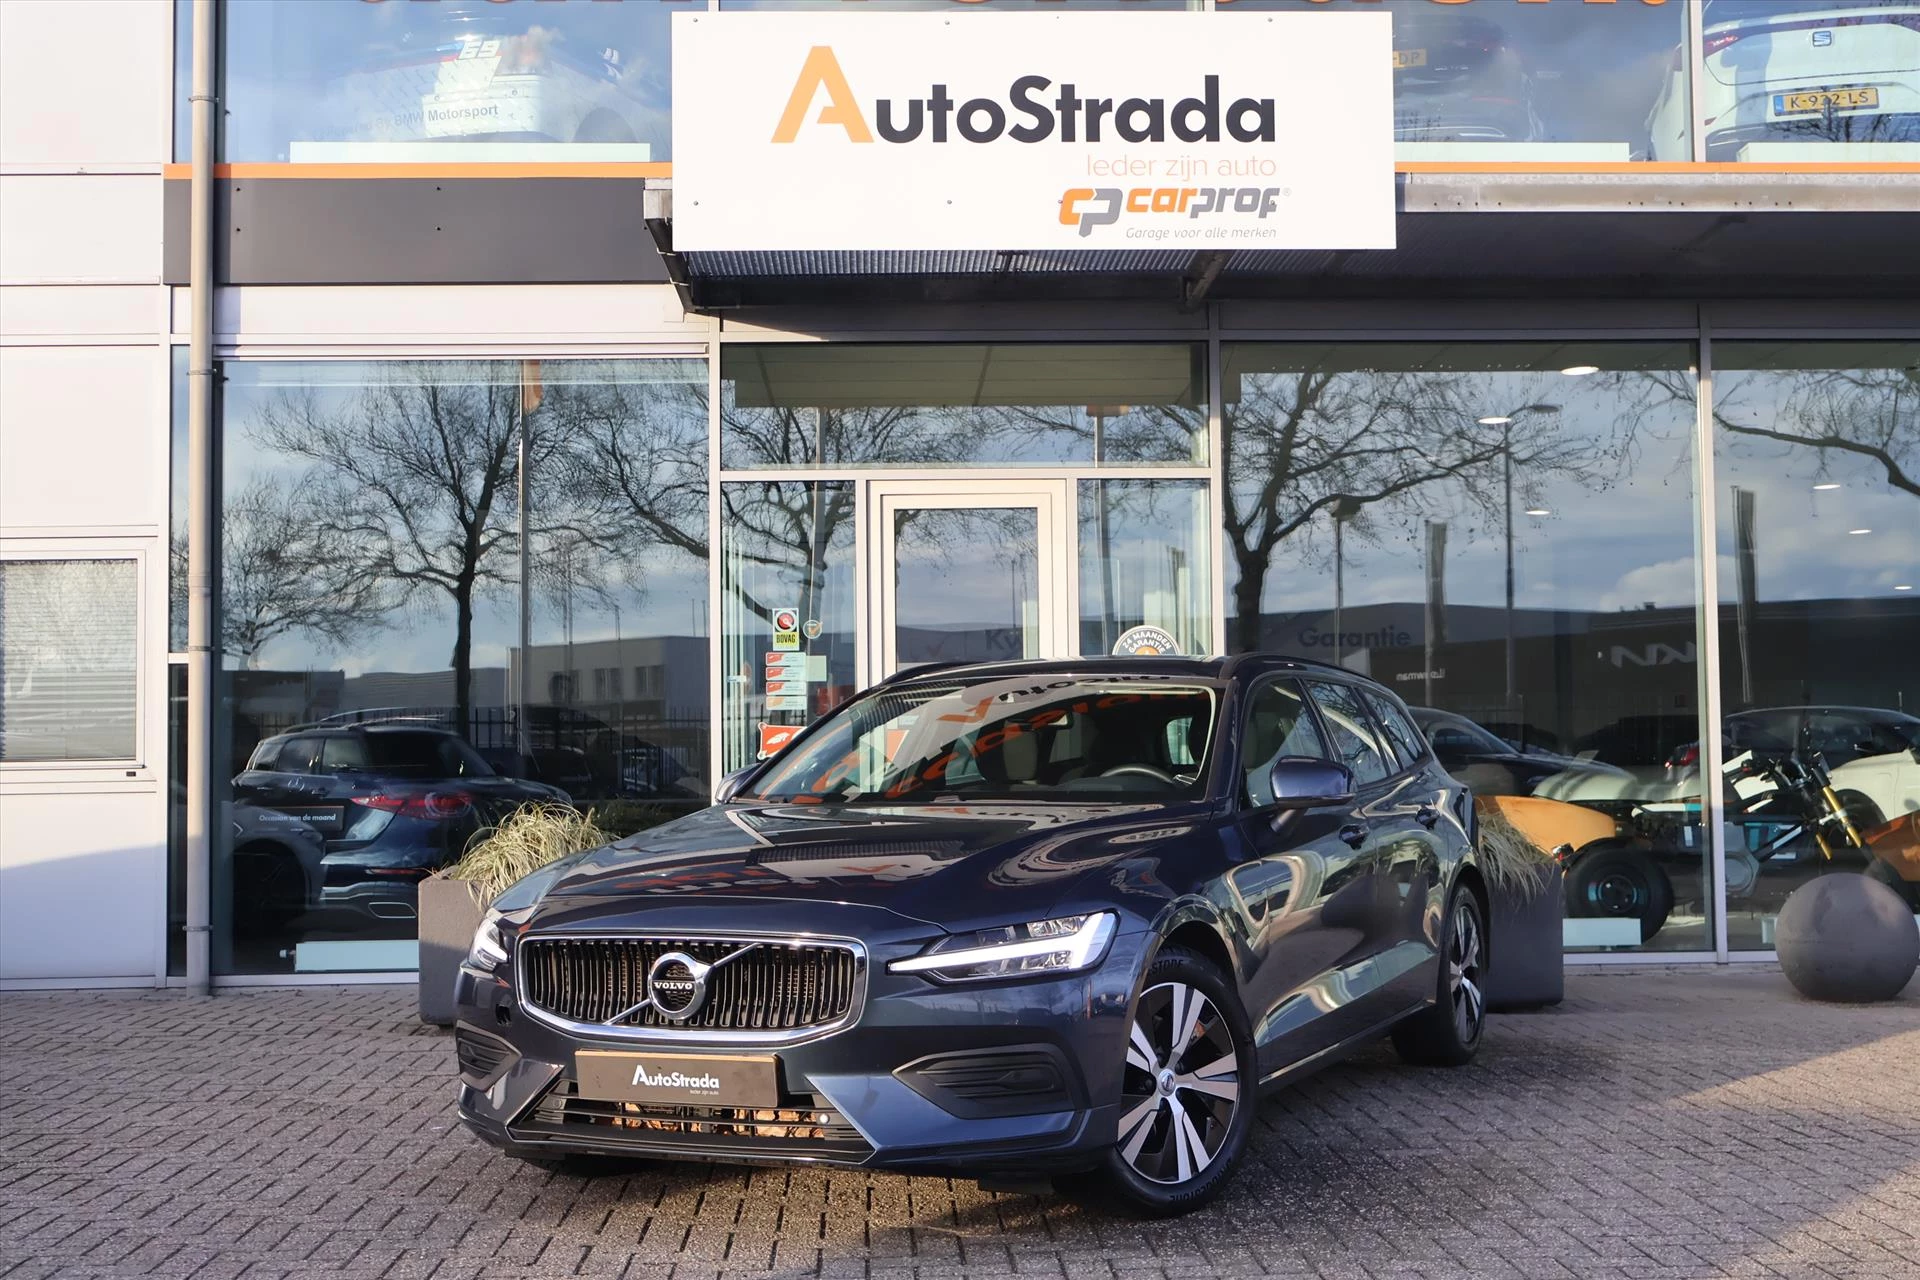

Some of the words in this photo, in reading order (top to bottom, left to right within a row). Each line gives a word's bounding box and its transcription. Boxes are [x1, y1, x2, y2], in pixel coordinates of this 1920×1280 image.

[458, 40, 501, 60] 69
[773, 46, 1276, 144] AutoStrada
[394, 111, 424, 127] BMW
[428, 104, 499, 122] Motorsport
[1087, 154, 1157, 177] Ieder
[1165, 154, 1208, 181] zijn
[1217, 156, 1277, 177] auto
[1126, 227, 1170, 241] Garage
[1174, 229, 1201, 239] voor
[1204, 227, 1228, 239] alle
[1231, 227, 1277, 239] merken
[776, 634, 796, 644] BOVAG
[1133, 631, 1172, 650] MAANDEN
[1298, 624, 1412, 647] Garantie
[653, 981, 693, 990] VOLVO
[632, 1064, 720, 1089] AutoStrada
